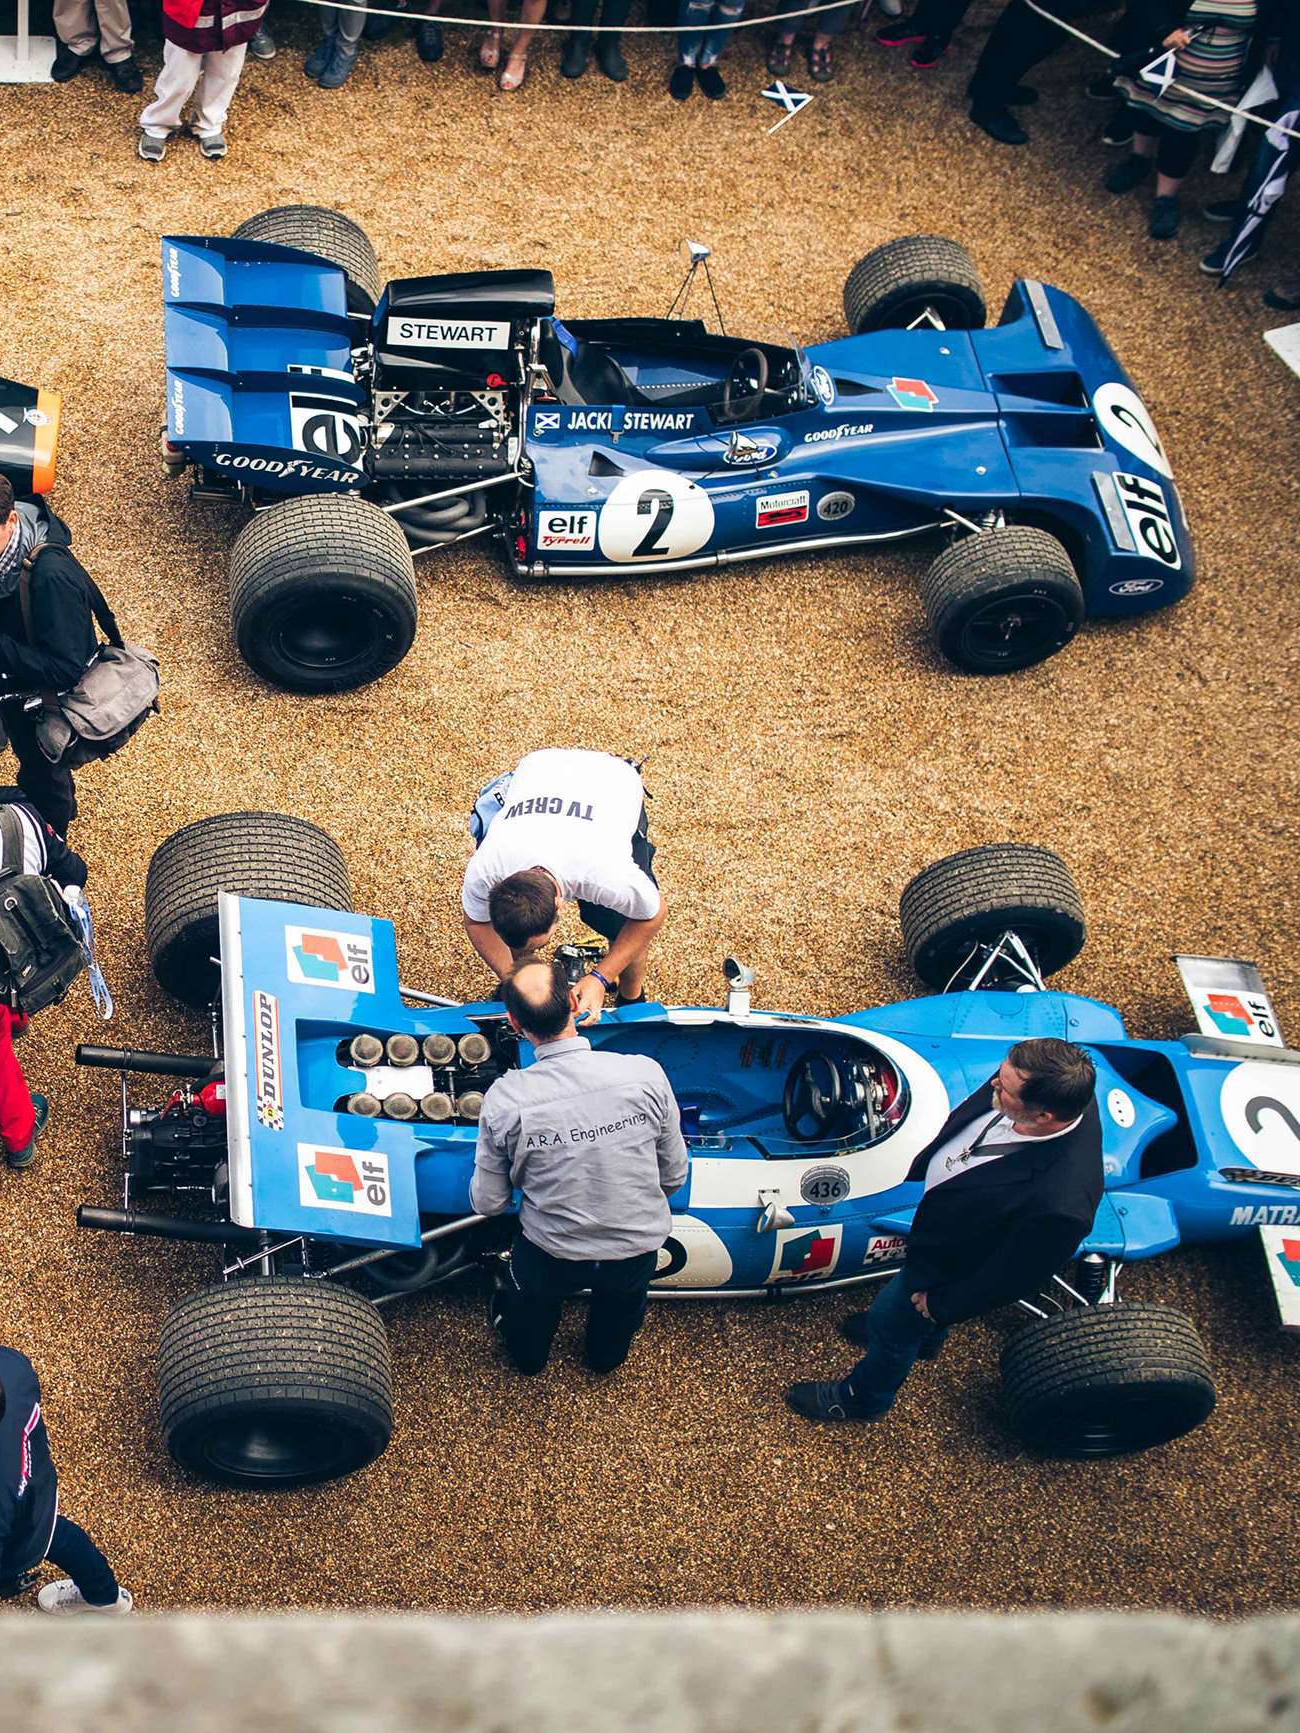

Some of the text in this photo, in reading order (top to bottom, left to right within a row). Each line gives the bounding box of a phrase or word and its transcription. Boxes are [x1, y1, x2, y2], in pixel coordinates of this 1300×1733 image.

[167, 248, 182, 297] GOODYEAR
[399, 322, 498, 342] STEWART
[172, 380, 187, 435] GOODYEAR
[567, 412, 695, 430] JACKI STEWART
[804, 424, 874, 443] GOODYEAR
[1110, 404, 1163, 459] 2
[215, 453, 360, 484] GOODYEAR
[760, 495, 807, 511] Motorcraft
[823, 500, 849, 515] 420
[547, 516, 588, 534] elf
[631, 488, 675, 558] 2
[1117, 475, 1178, 564] elf
[542, 536, 591, 547] Tyrrell
[1118, 580, 1154, 594] Ford
[504, 796, 594, 821] TV CREW
[347, 942, 370, 985] elf
[1249, 999, 1276, 1039] elf
[259, 993, 277, 1101] DUNLOP
[526, 1112, 647, 1148] A.R.A. Engineering
[362, 1159, 386, 1207] elf
[809, 1182, 841, 1199] 436
[1230, 1206, 1300, 1227] MATR
[872, 1236, 908, 1251] Auto
